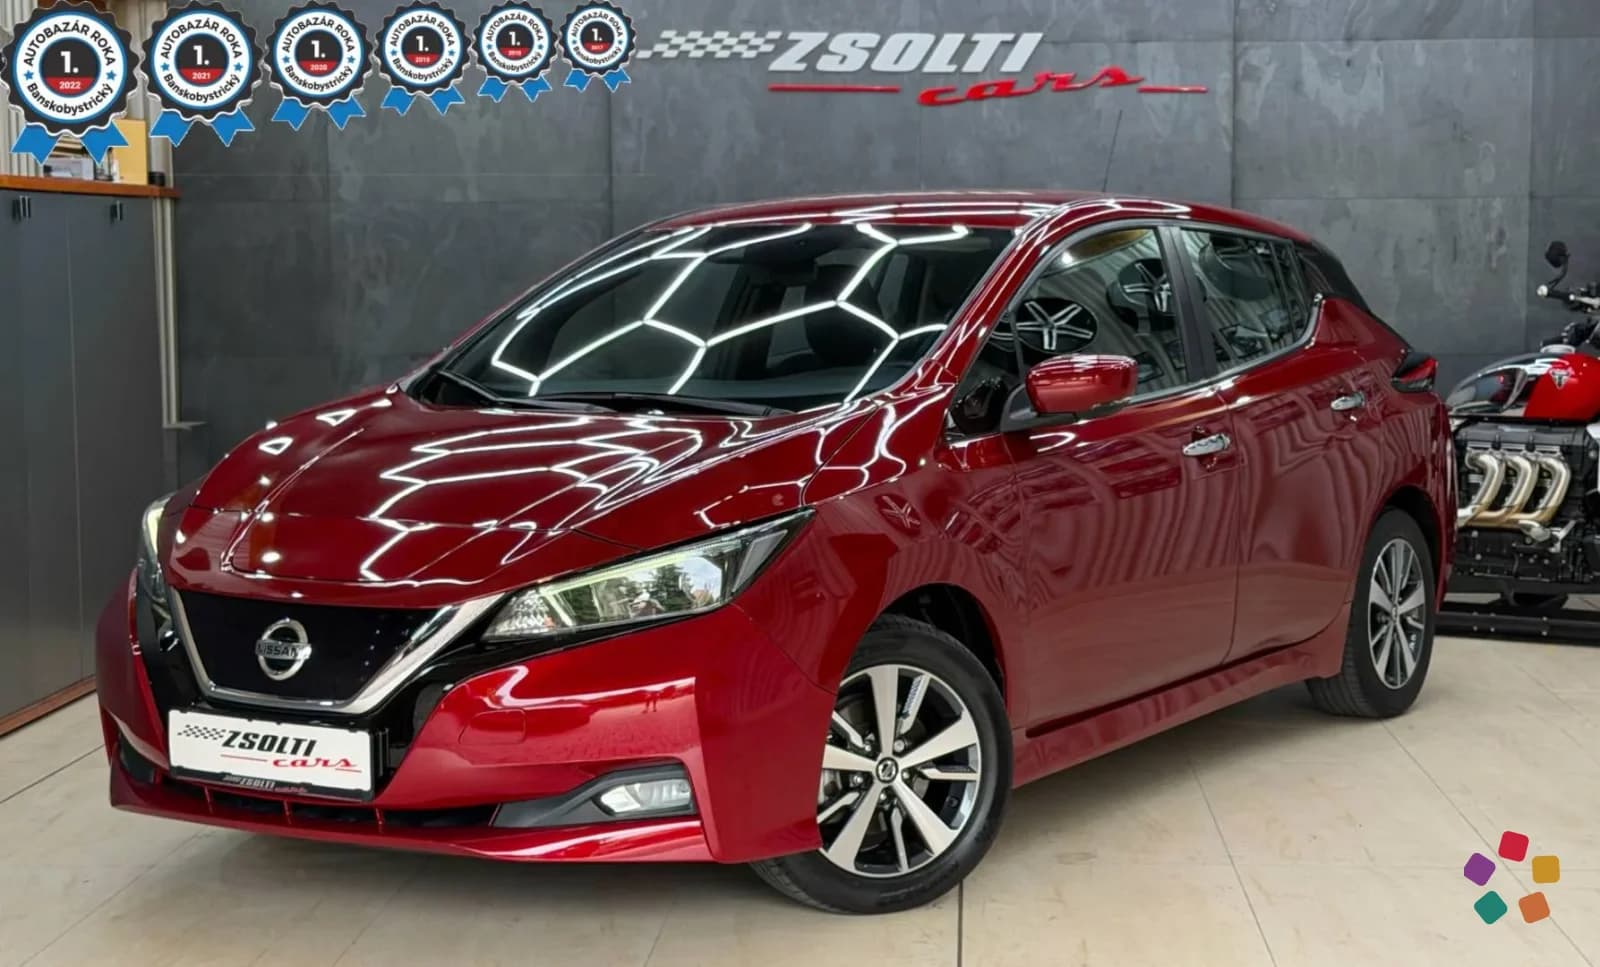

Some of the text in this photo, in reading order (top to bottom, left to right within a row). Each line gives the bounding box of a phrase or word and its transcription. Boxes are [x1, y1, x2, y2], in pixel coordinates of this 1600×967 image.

[768, 31, 1044, 73] ZSOLTI
[917, 65, 1146, 107] cars
[222, 730, 318, 757] ZSOLTI
[272, 756, 358, 769] cars
